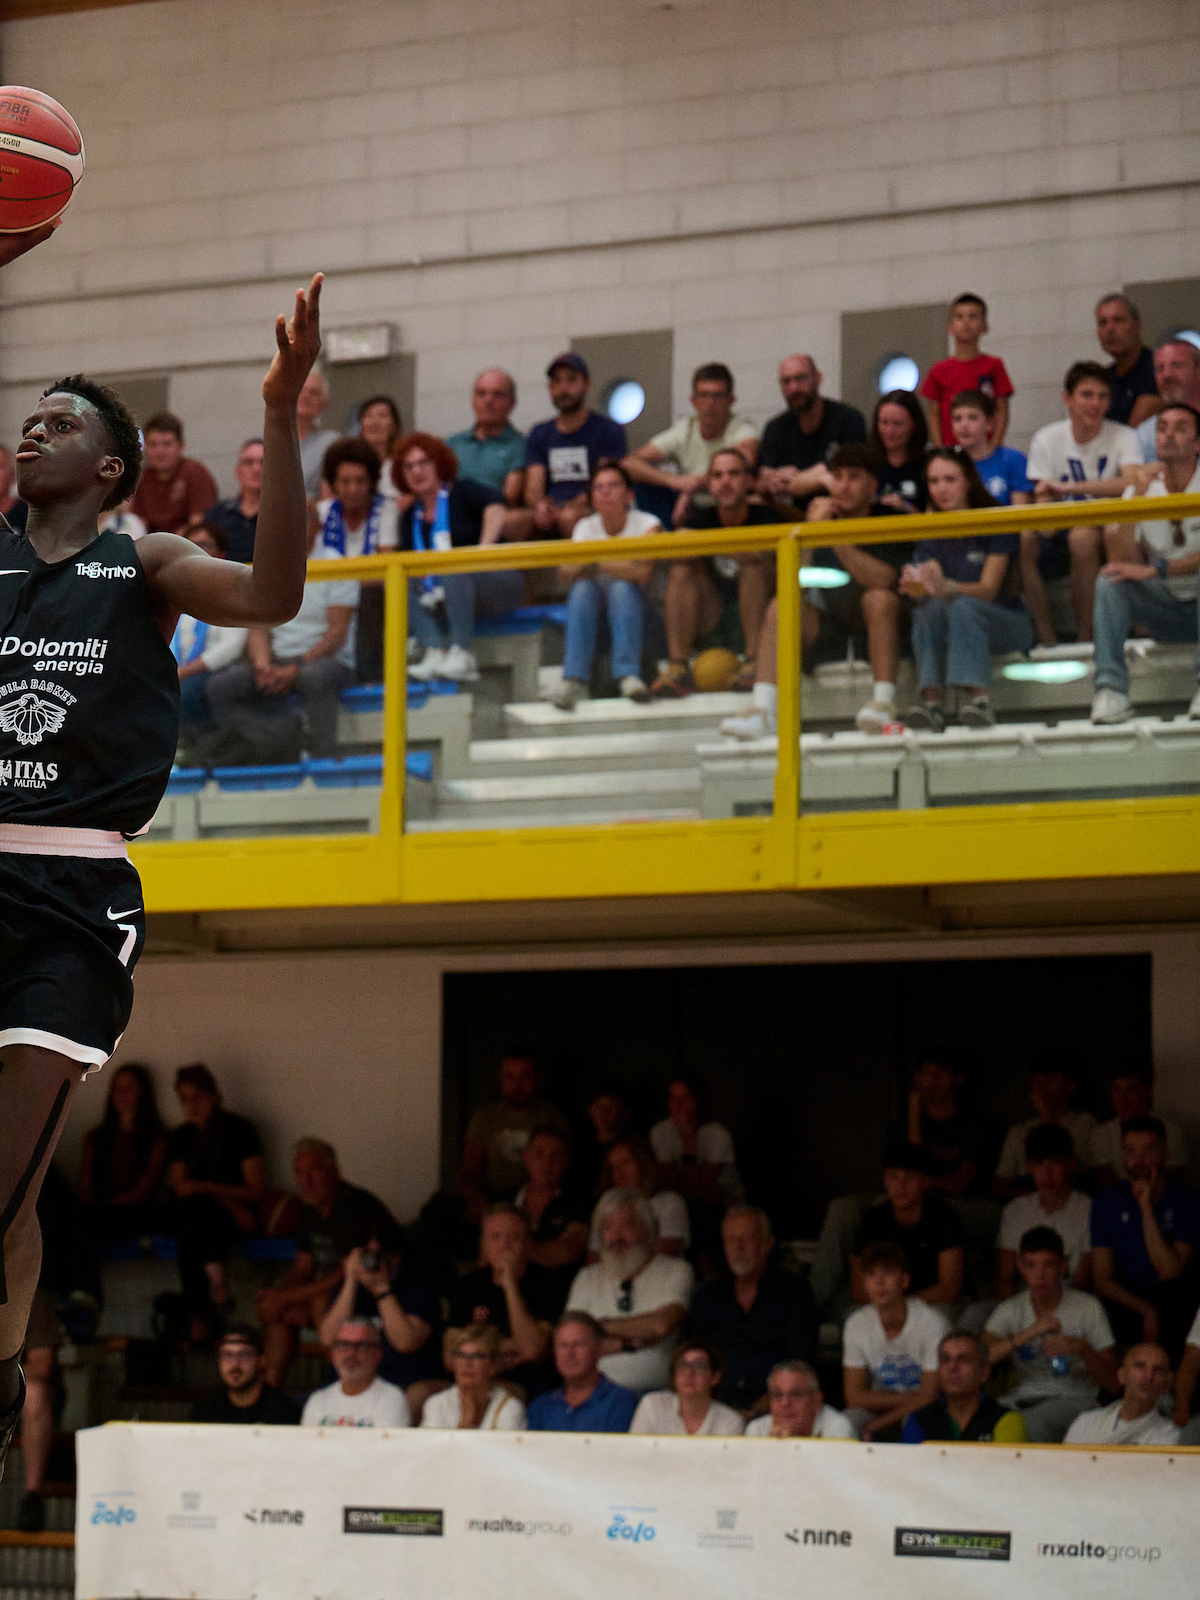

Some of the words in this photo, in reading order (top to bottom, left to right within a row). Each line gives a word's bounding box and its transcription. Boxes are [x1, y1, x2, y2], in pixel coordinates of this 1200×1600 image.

[0, 101, 31, 116] FIBA
[75, 562, 136, 579] TRENTINO
[0, 636, 109, 659] Dolomiti
[33, 659, 104, 676] energia
[30, 678, 77, 707] BASKET
[14, 760, 58, 781] ITAS
[14, 779, 47, 789] MUTUA
[117, 924, 137, 967] 7
[261, 1509, 305, 1525] nine
[803, 1529, 853, 1546] nine
[1042, 1540, 1162, 1563] rixaltogroup
